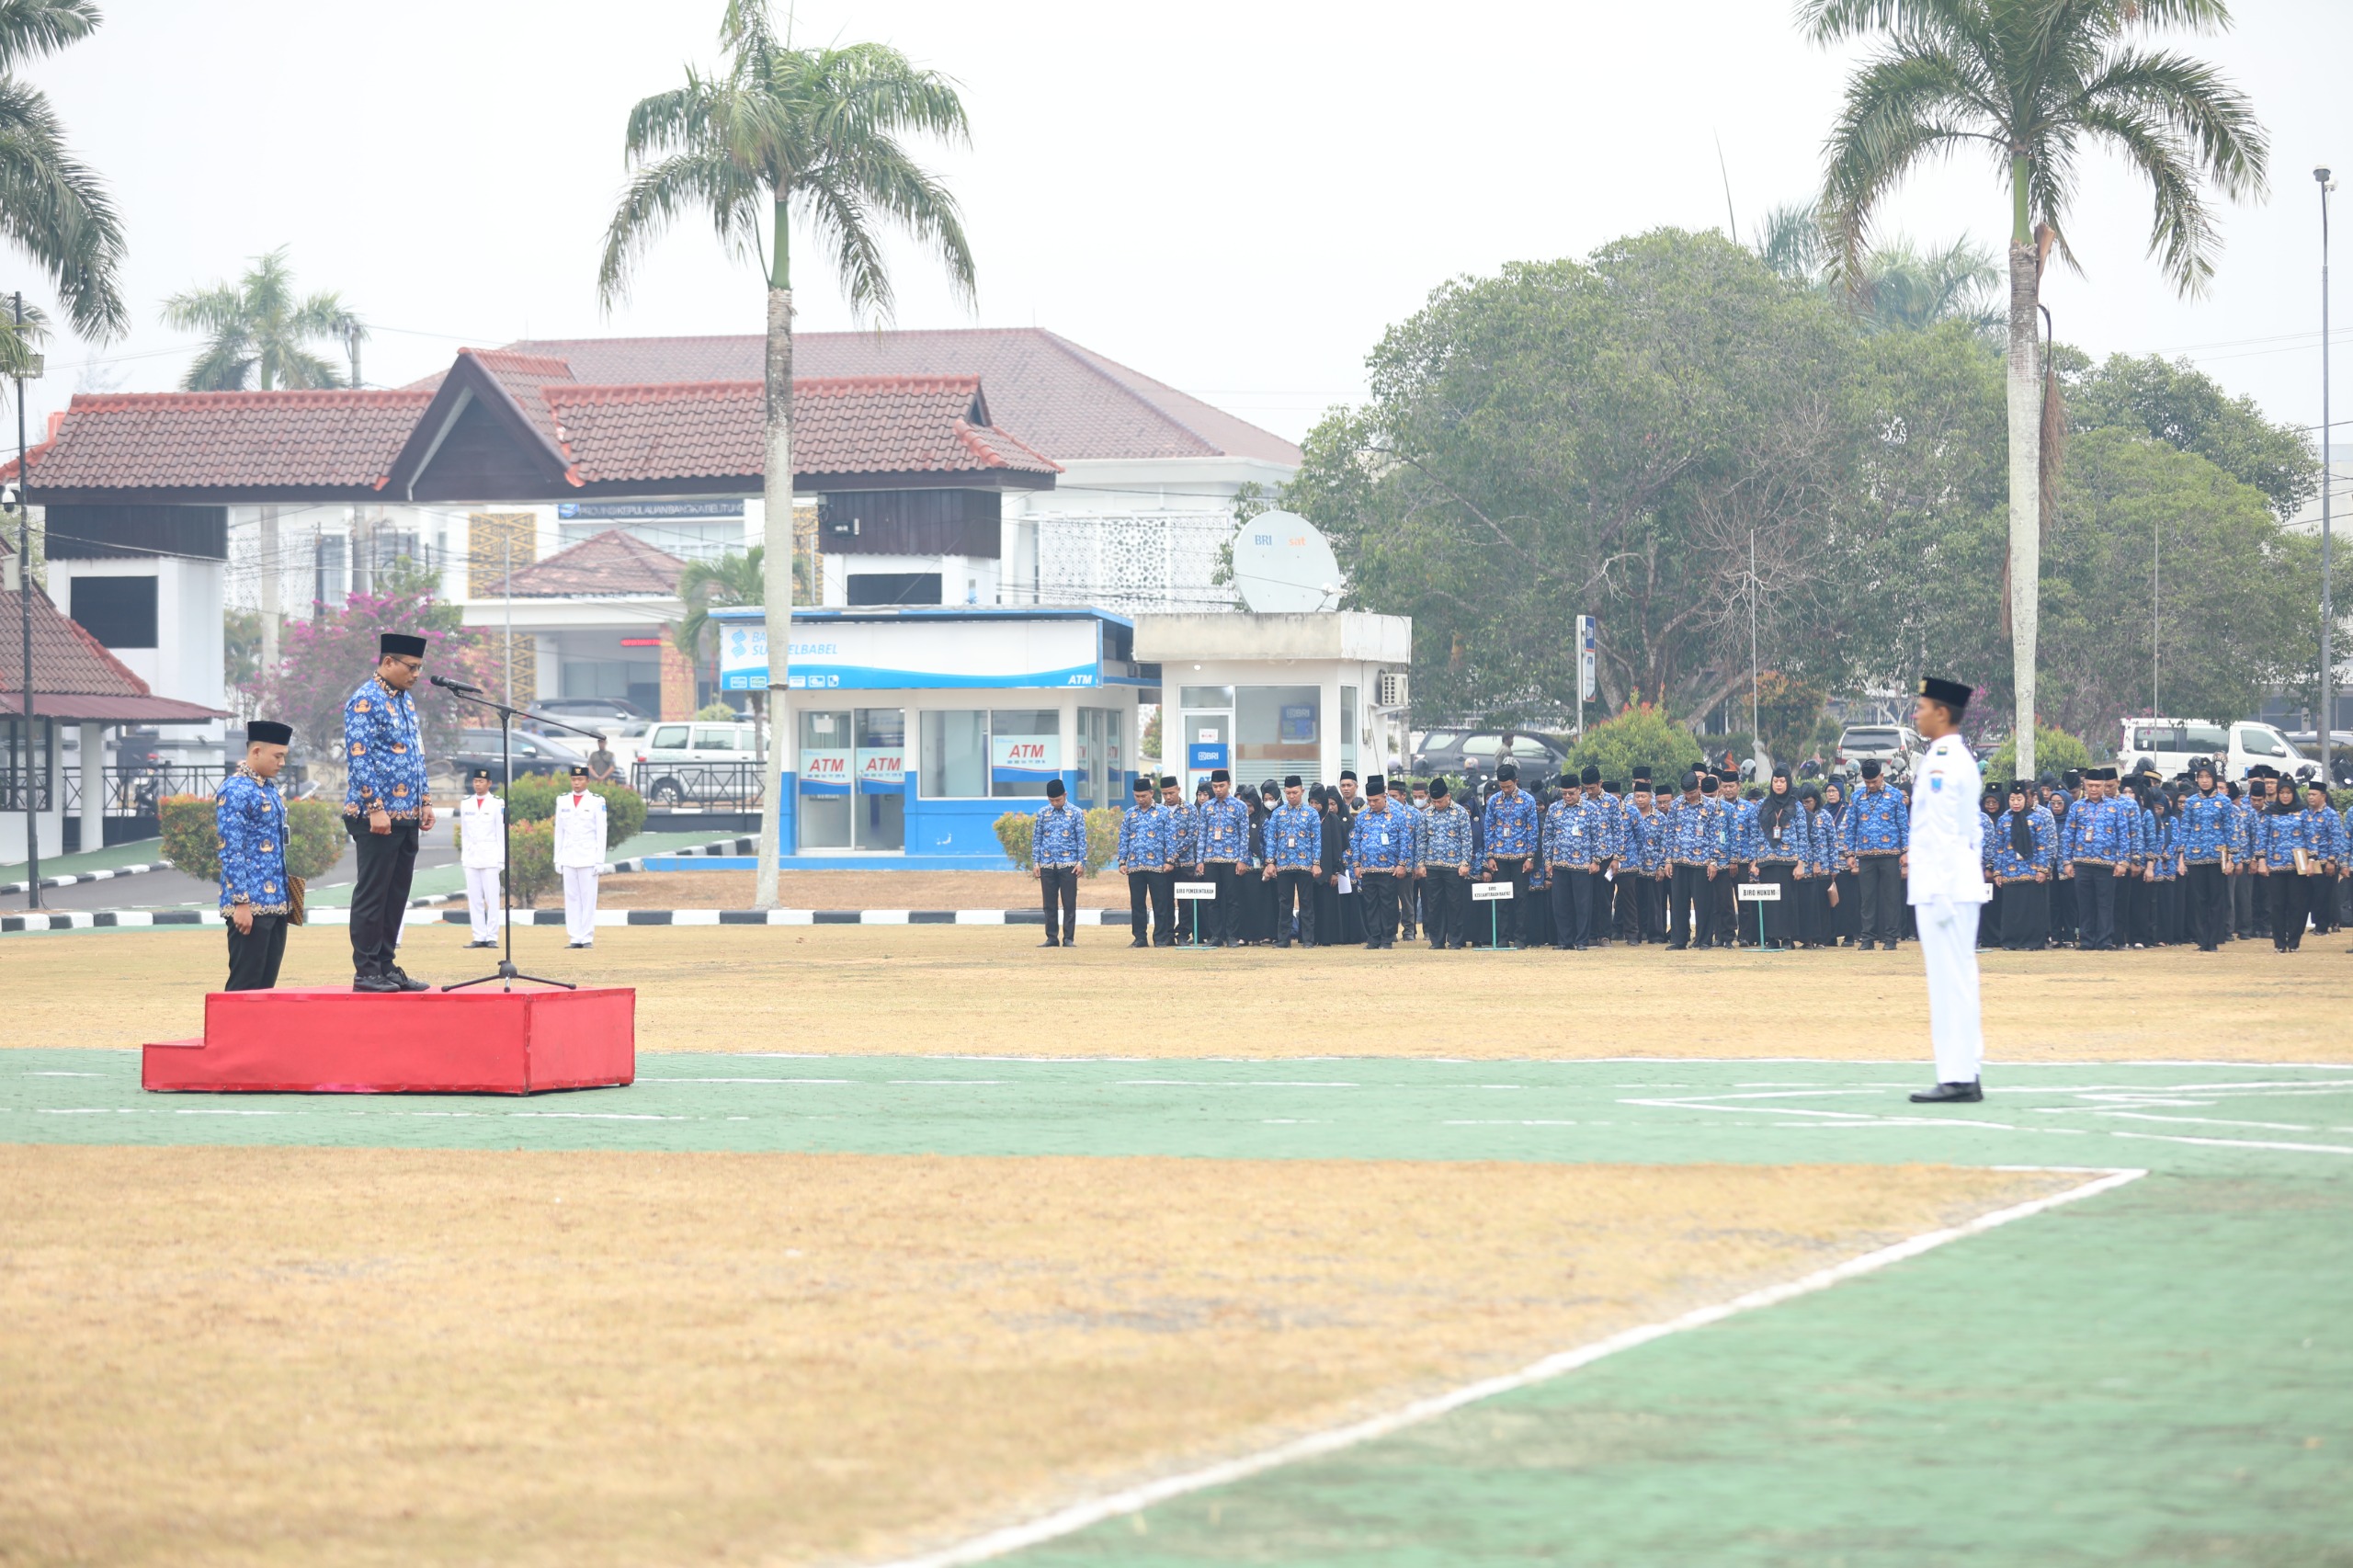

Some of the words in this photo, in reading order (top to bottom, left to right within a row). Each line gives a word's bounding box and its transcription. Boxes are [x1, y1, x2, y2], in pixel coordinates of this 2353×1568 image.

[1255, 535, 1272, 545] BRI
[752, 643, 837, 655] SUELBABEL
[1068, 675, 1092, 685] ATM
[1009, 744, 1045, 758] ATM
[809, 758, 845, 772] ATM
[867, 756, 901, 771] ATM
